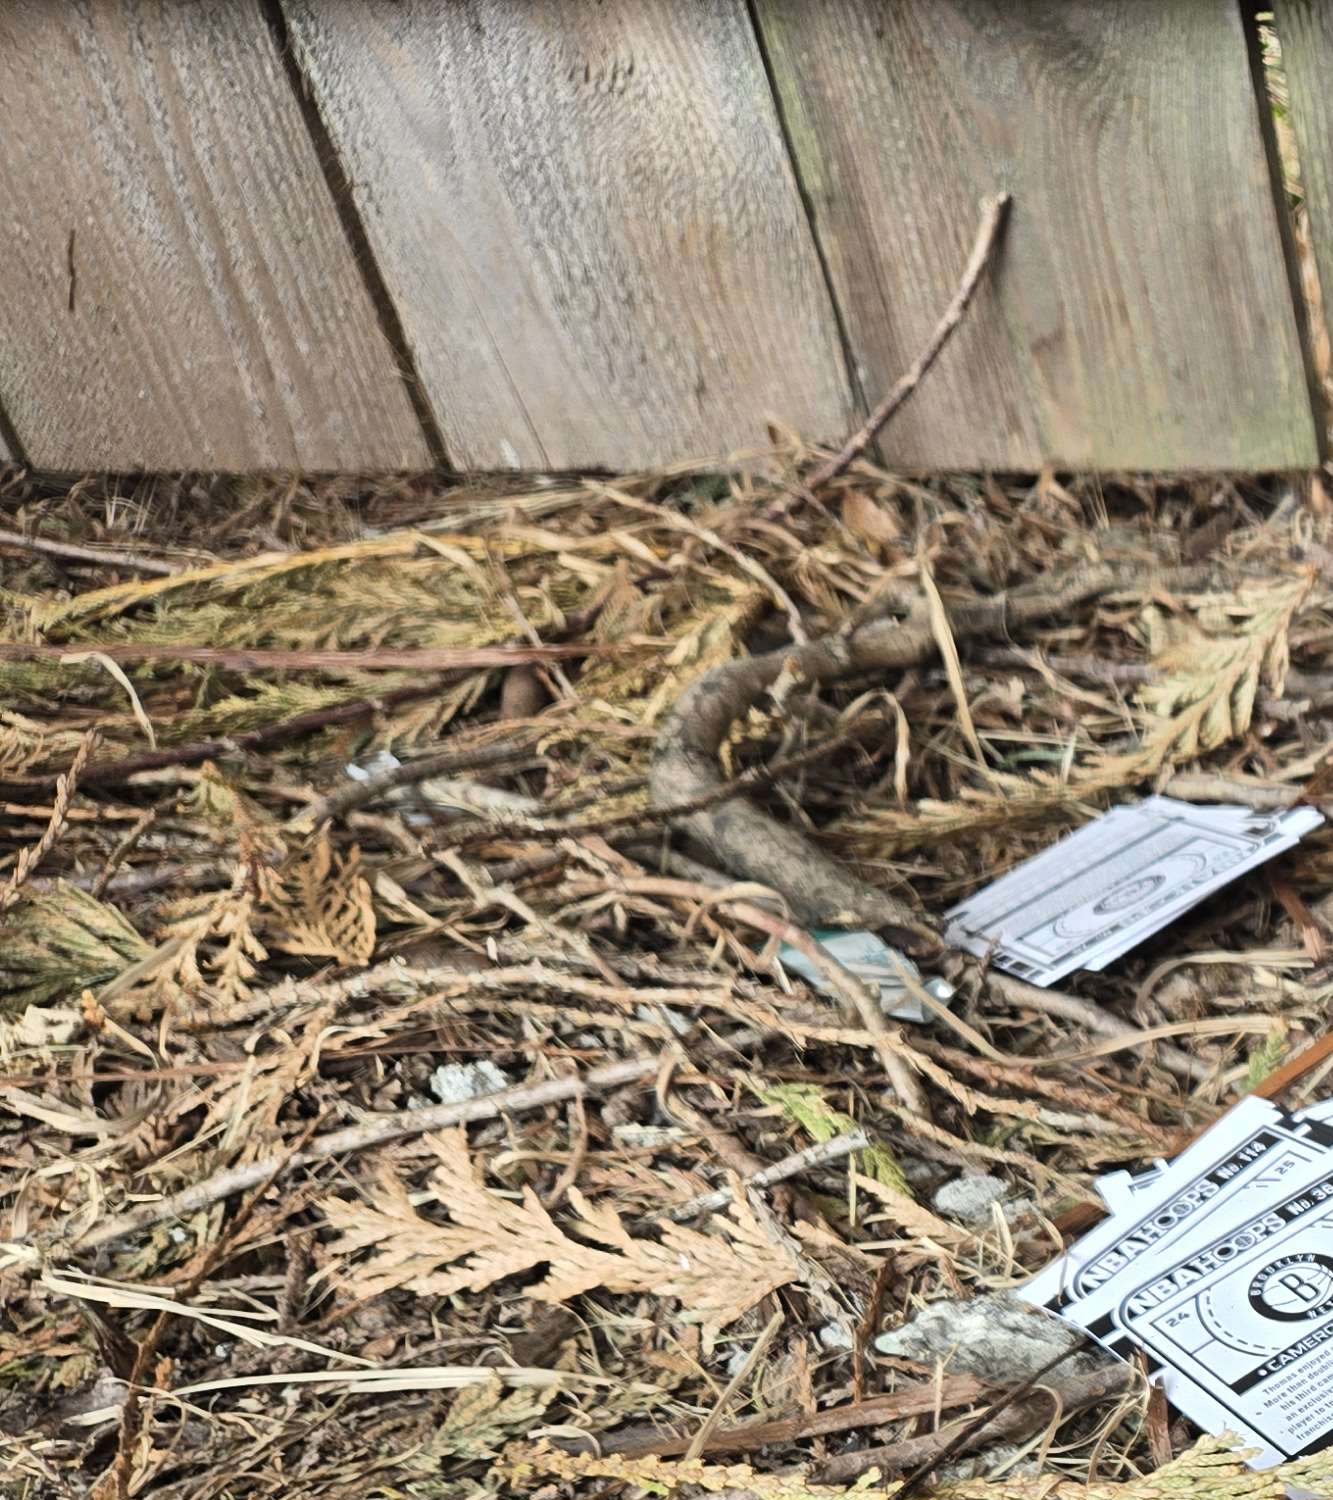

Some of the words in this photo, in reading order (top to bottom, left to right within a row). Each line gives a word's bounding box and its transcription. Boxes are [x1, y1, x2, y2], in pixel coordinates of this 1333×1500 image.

[1272, 1155, 1297, 1178] 25
[1077, 1233, 1146, 1293] NBA
[1133, 1174, 1221, 1249] HOOPS
[1238, 1136, 1268, 1164] 114
[1123, 1262, 1205, 1317] NBA
[1188, 1210, 1289, 1276] HOOPS
[1282, 1194, 1316, 1217] No.
[1250, 1253, 1317, 1297] BROOKLYN
[1277, 1272, 1321, 1304] B
[1163, 1309, 1192, 1329] 24
[1260, 1370, 1299, 1396] Thomas
[1278, 1397, 1298, 1411] his
[1293, 1383, 1319, 1401] third
[1285, 1376, 1310, 1394] than
[1283, 1410, 1299, 1422] an
[1285, 1412, 1318, 1435] player
[1313, 1405, 1327, 1415] to
